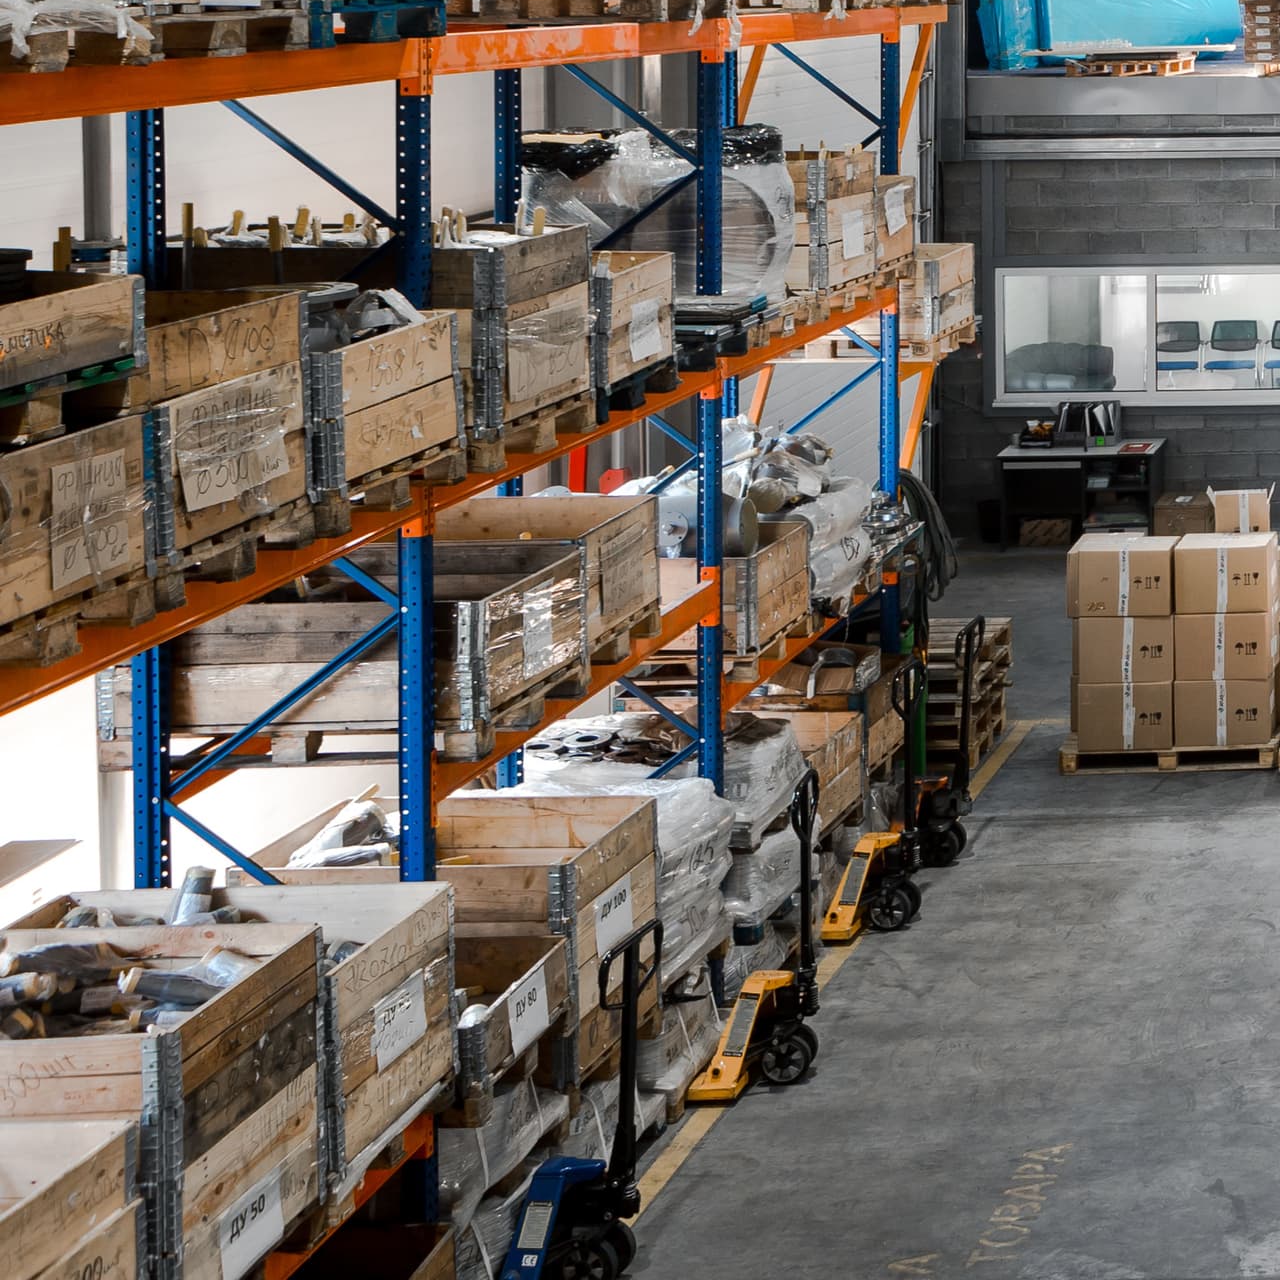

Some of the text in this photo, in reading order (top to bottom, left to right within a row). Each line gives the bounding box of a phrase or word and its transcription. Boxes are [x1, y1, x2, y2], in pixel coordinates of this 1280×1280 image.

[601, 888, 627, 920] ДУ 100
[515, 986, 538, 1019] ДУ 80
[229, 1192, 267, 1245] ДУ 50
[964, 1141, 1074, 1270] ТОВАРА
